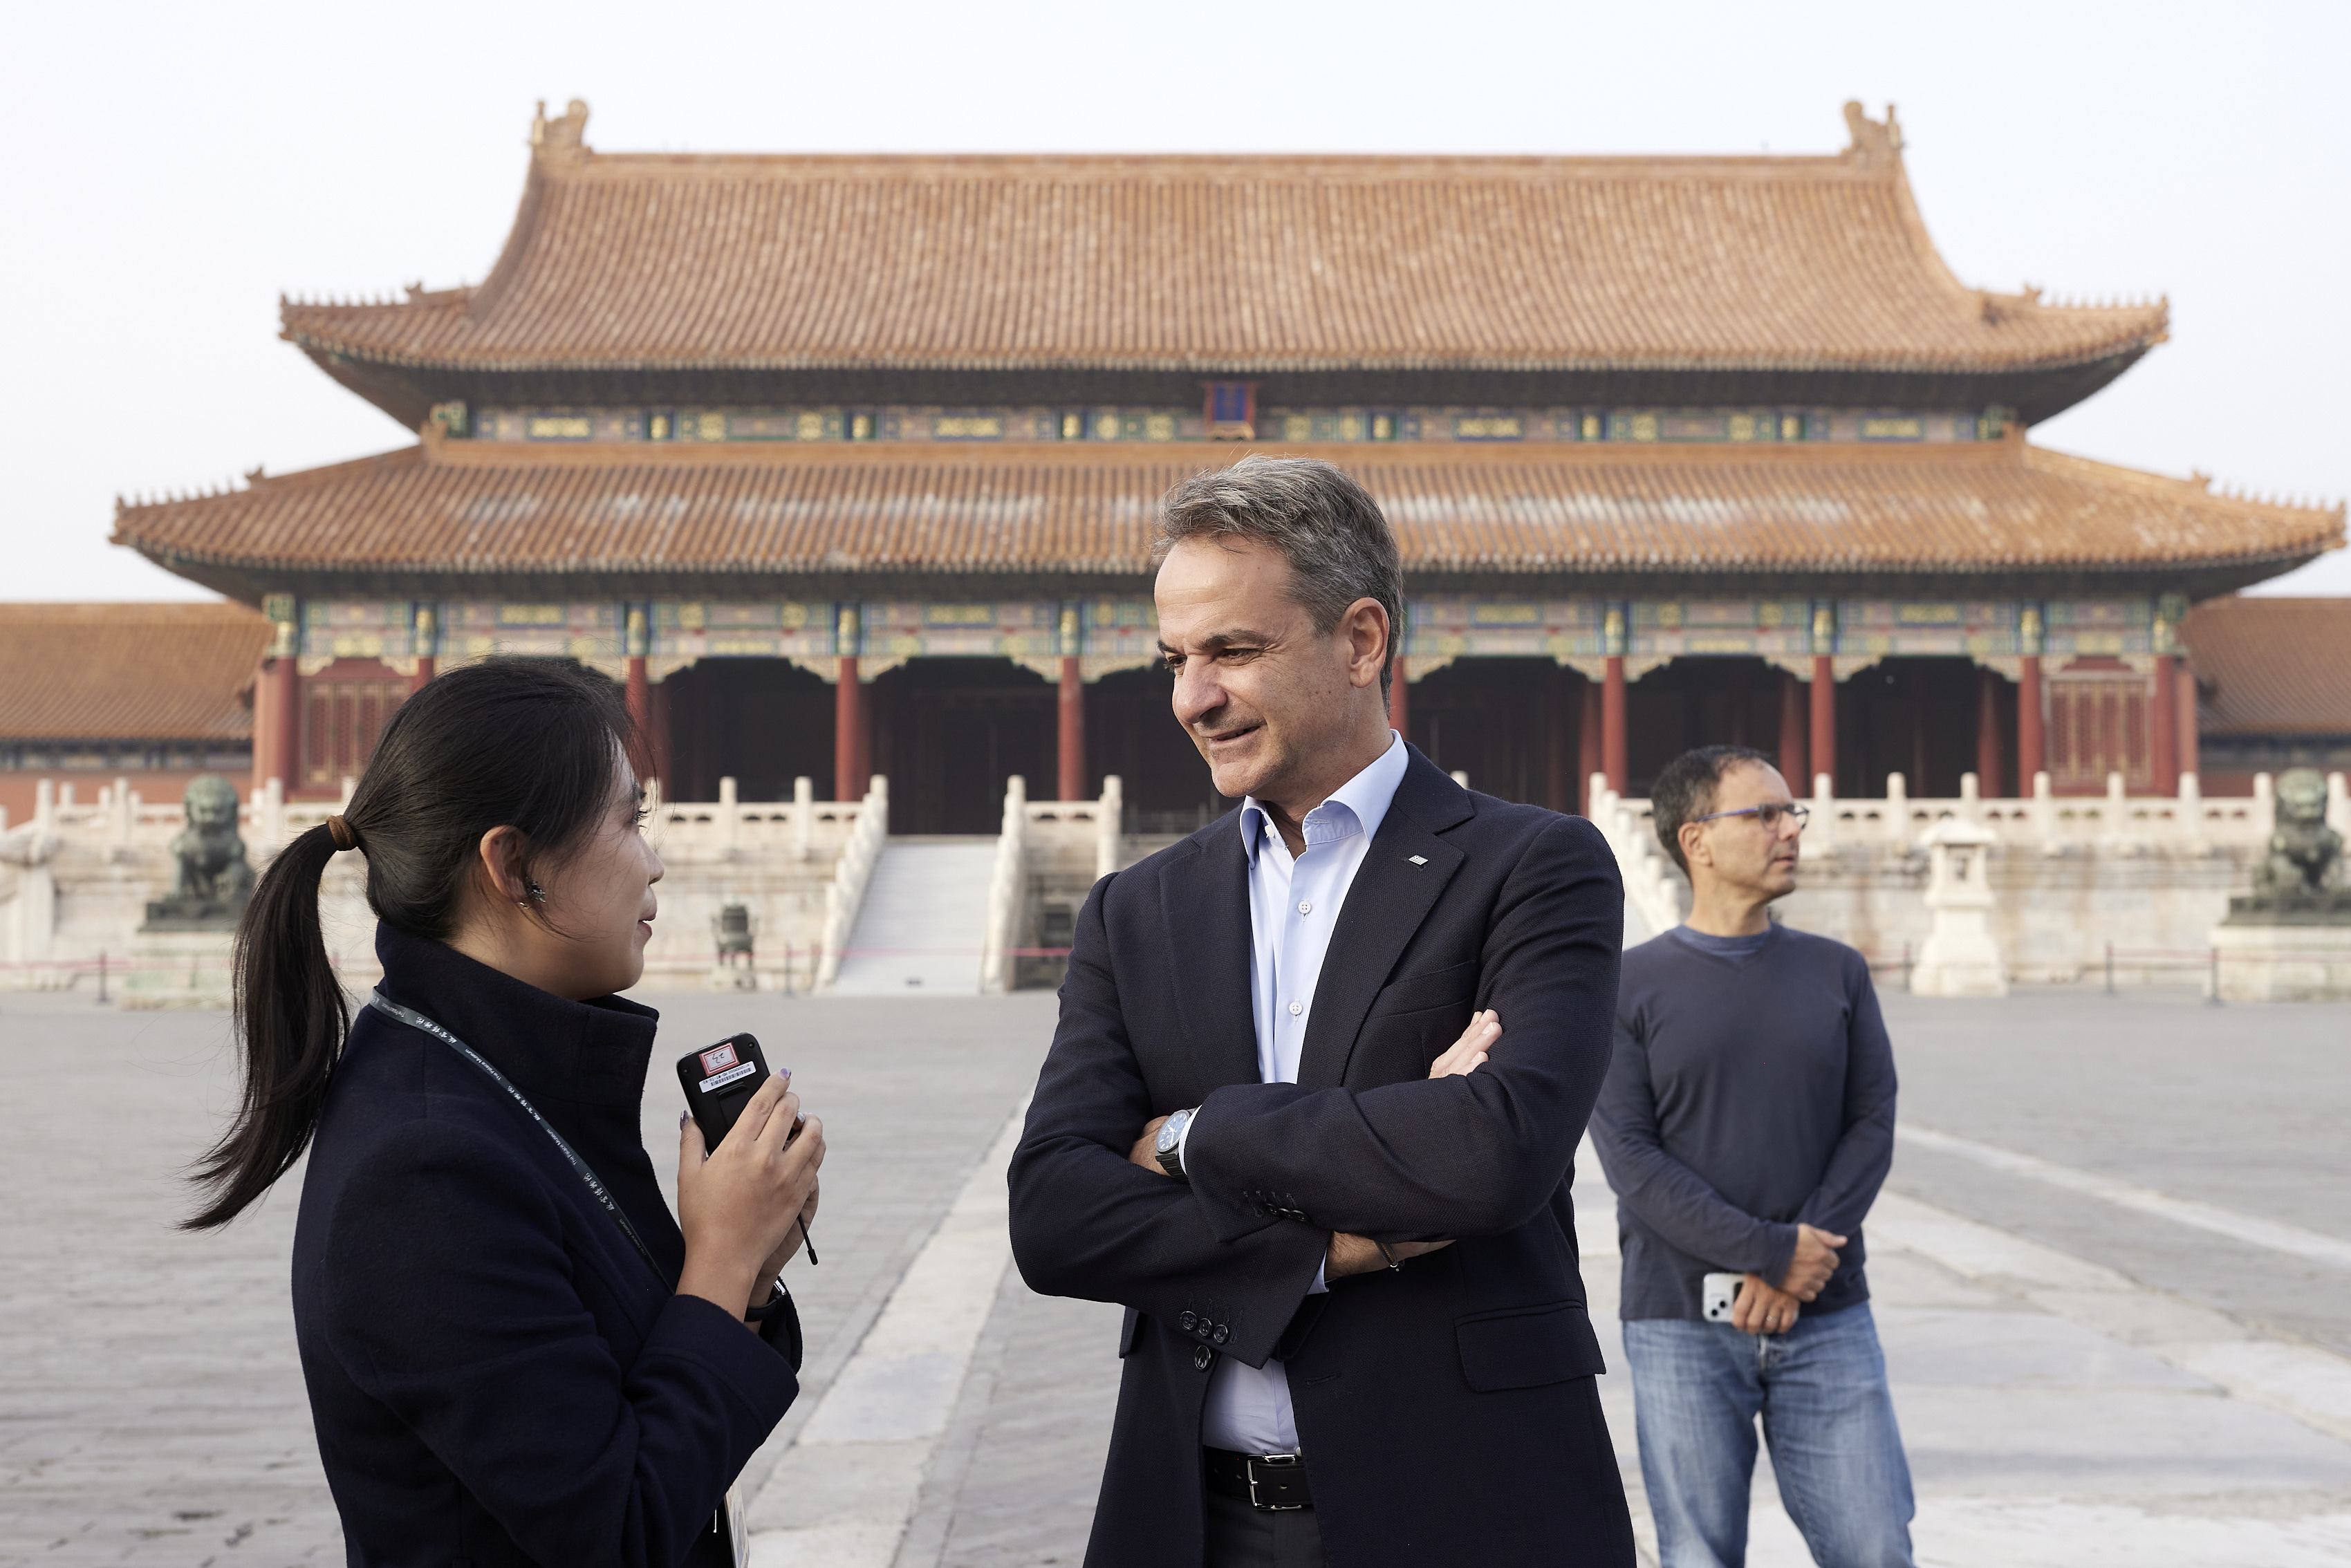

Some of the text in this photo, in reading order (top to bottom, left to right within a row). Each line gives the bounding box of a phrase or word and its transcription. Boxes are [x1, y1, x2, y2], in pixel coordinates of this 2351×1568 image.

[465, 1048, 483, 1063] Museum
[480, 1061, 495, 1074] Palace
[546, 1128, 561, 1146] Museum
[559, 1144, 573, 1158] Palace
[619, 1218, 633, 1235] Museum
